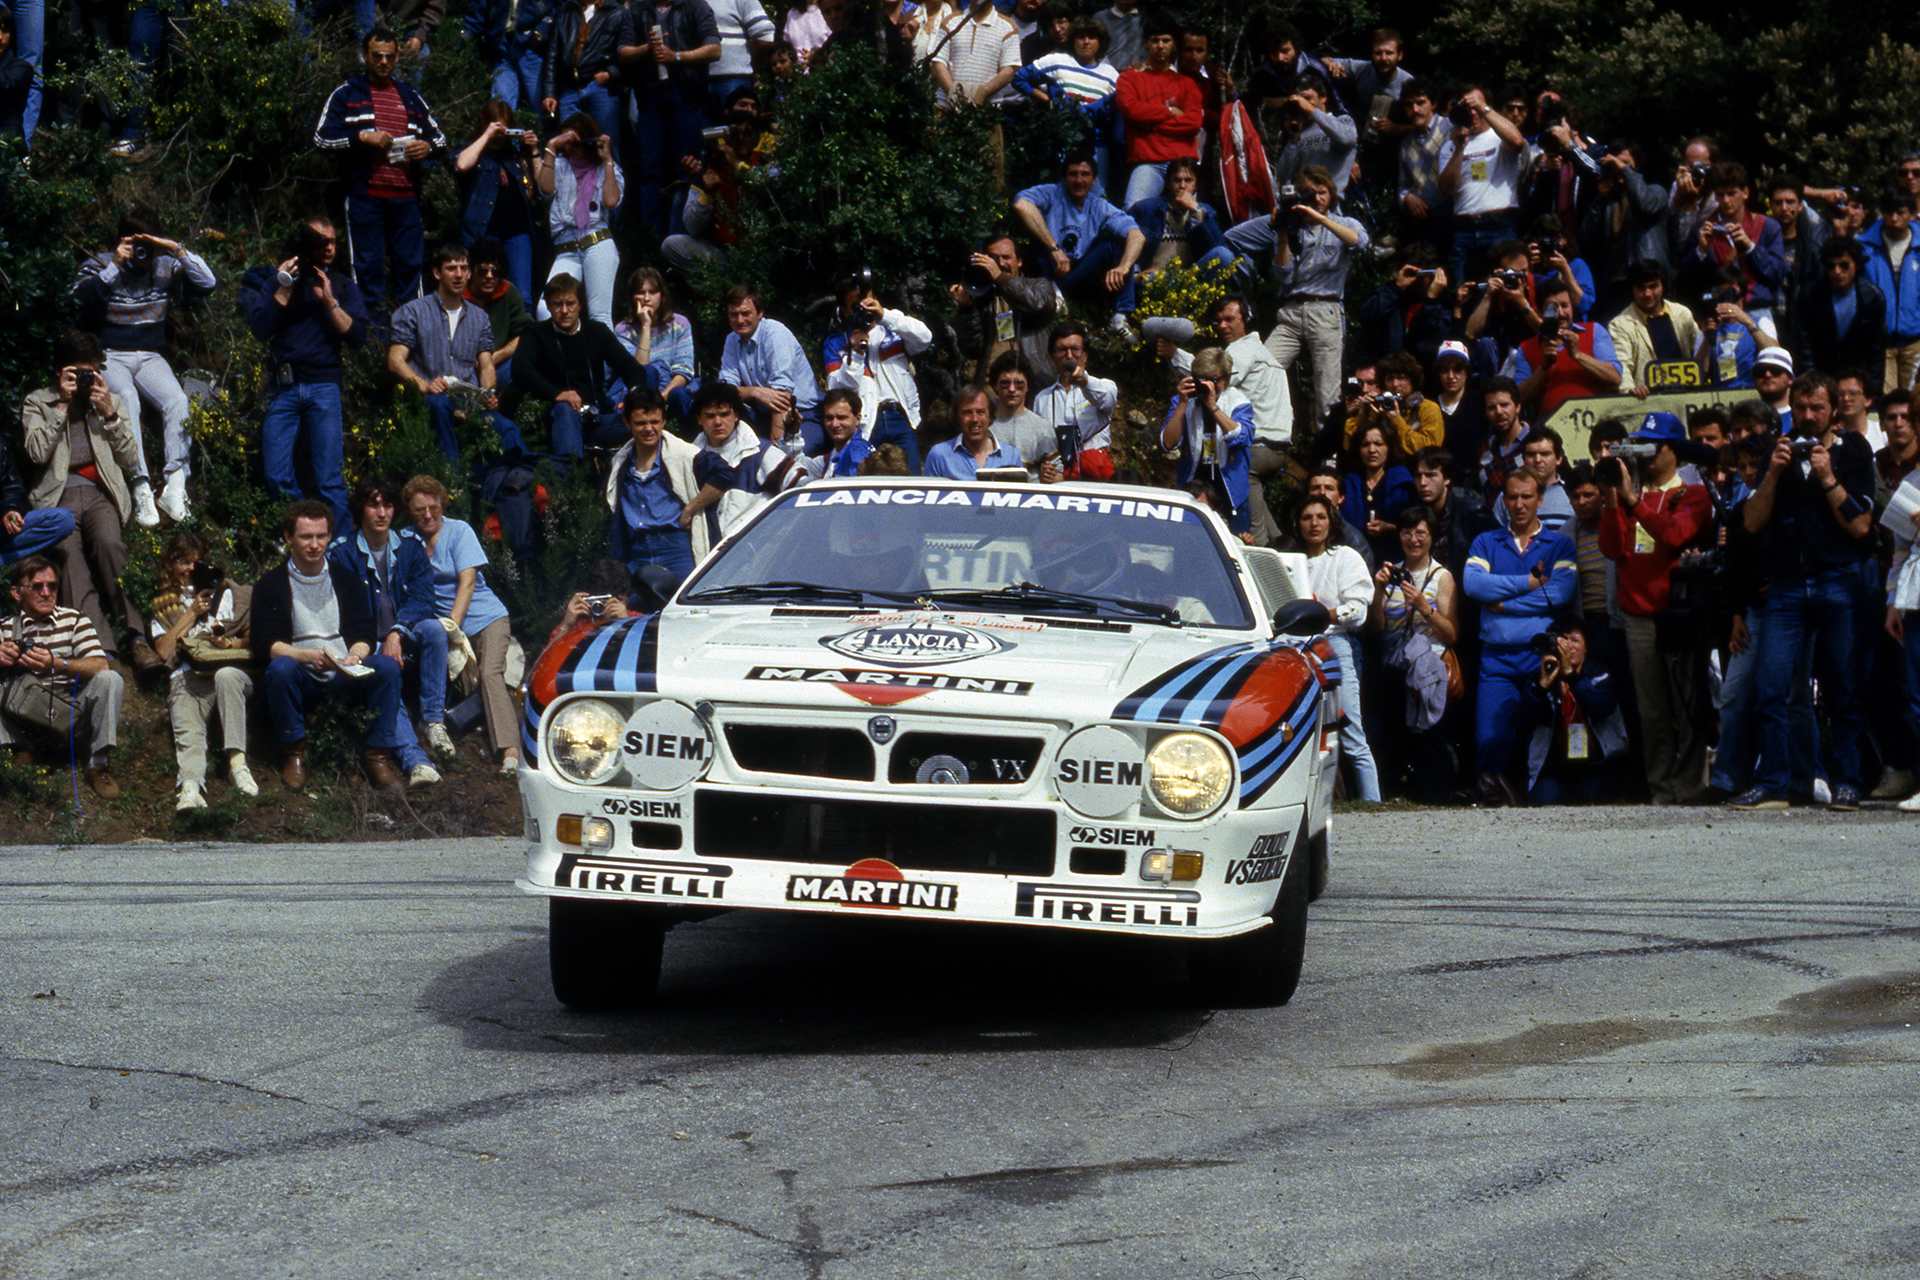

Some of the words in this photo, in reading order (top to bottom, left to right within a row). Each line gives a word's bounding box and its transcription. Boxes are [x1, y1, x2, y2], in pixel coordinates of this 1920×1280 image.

[795, 488, 972, 508] LANCIA
[980, 491, 1184, 523] MARTINI
[870, 633, 964, 650] LANCIA
[757, 667, 1020, 695] MARTINI
[623, 730, 706, 761] SIEM
[992, 758, 1028, 781] VX
[1058, 758, 1143, 787] SIEM
[629, 800, 682, 819] SIEM
[1098, 827, 1156, 847] SIEM
[554, 853, 734, 899] PIRELLI
[792, 877, 953, 909] MARTINI
[1014, 881, 1202, 927] PIRELLI
